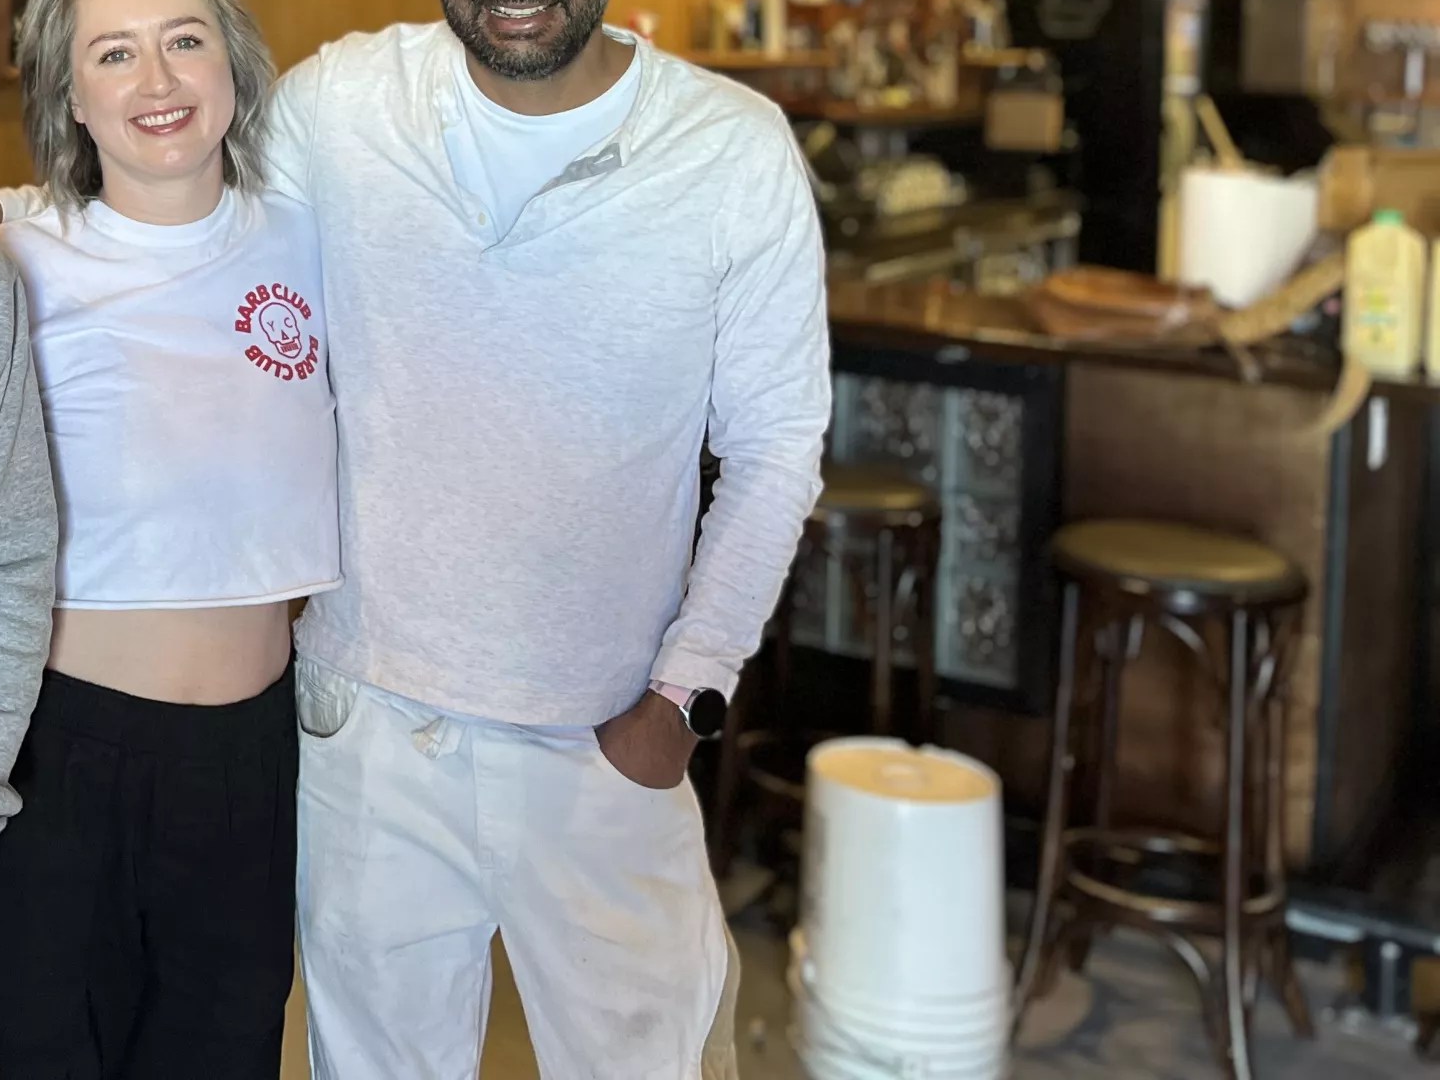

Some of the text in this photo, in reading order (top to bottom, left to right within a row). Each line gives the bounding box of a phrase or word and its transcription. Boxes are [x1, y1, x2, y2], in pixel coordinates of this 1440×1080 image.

[234, 282, 312, 334] BARB CLUB
[244, 344, 294, 381] CLUB
